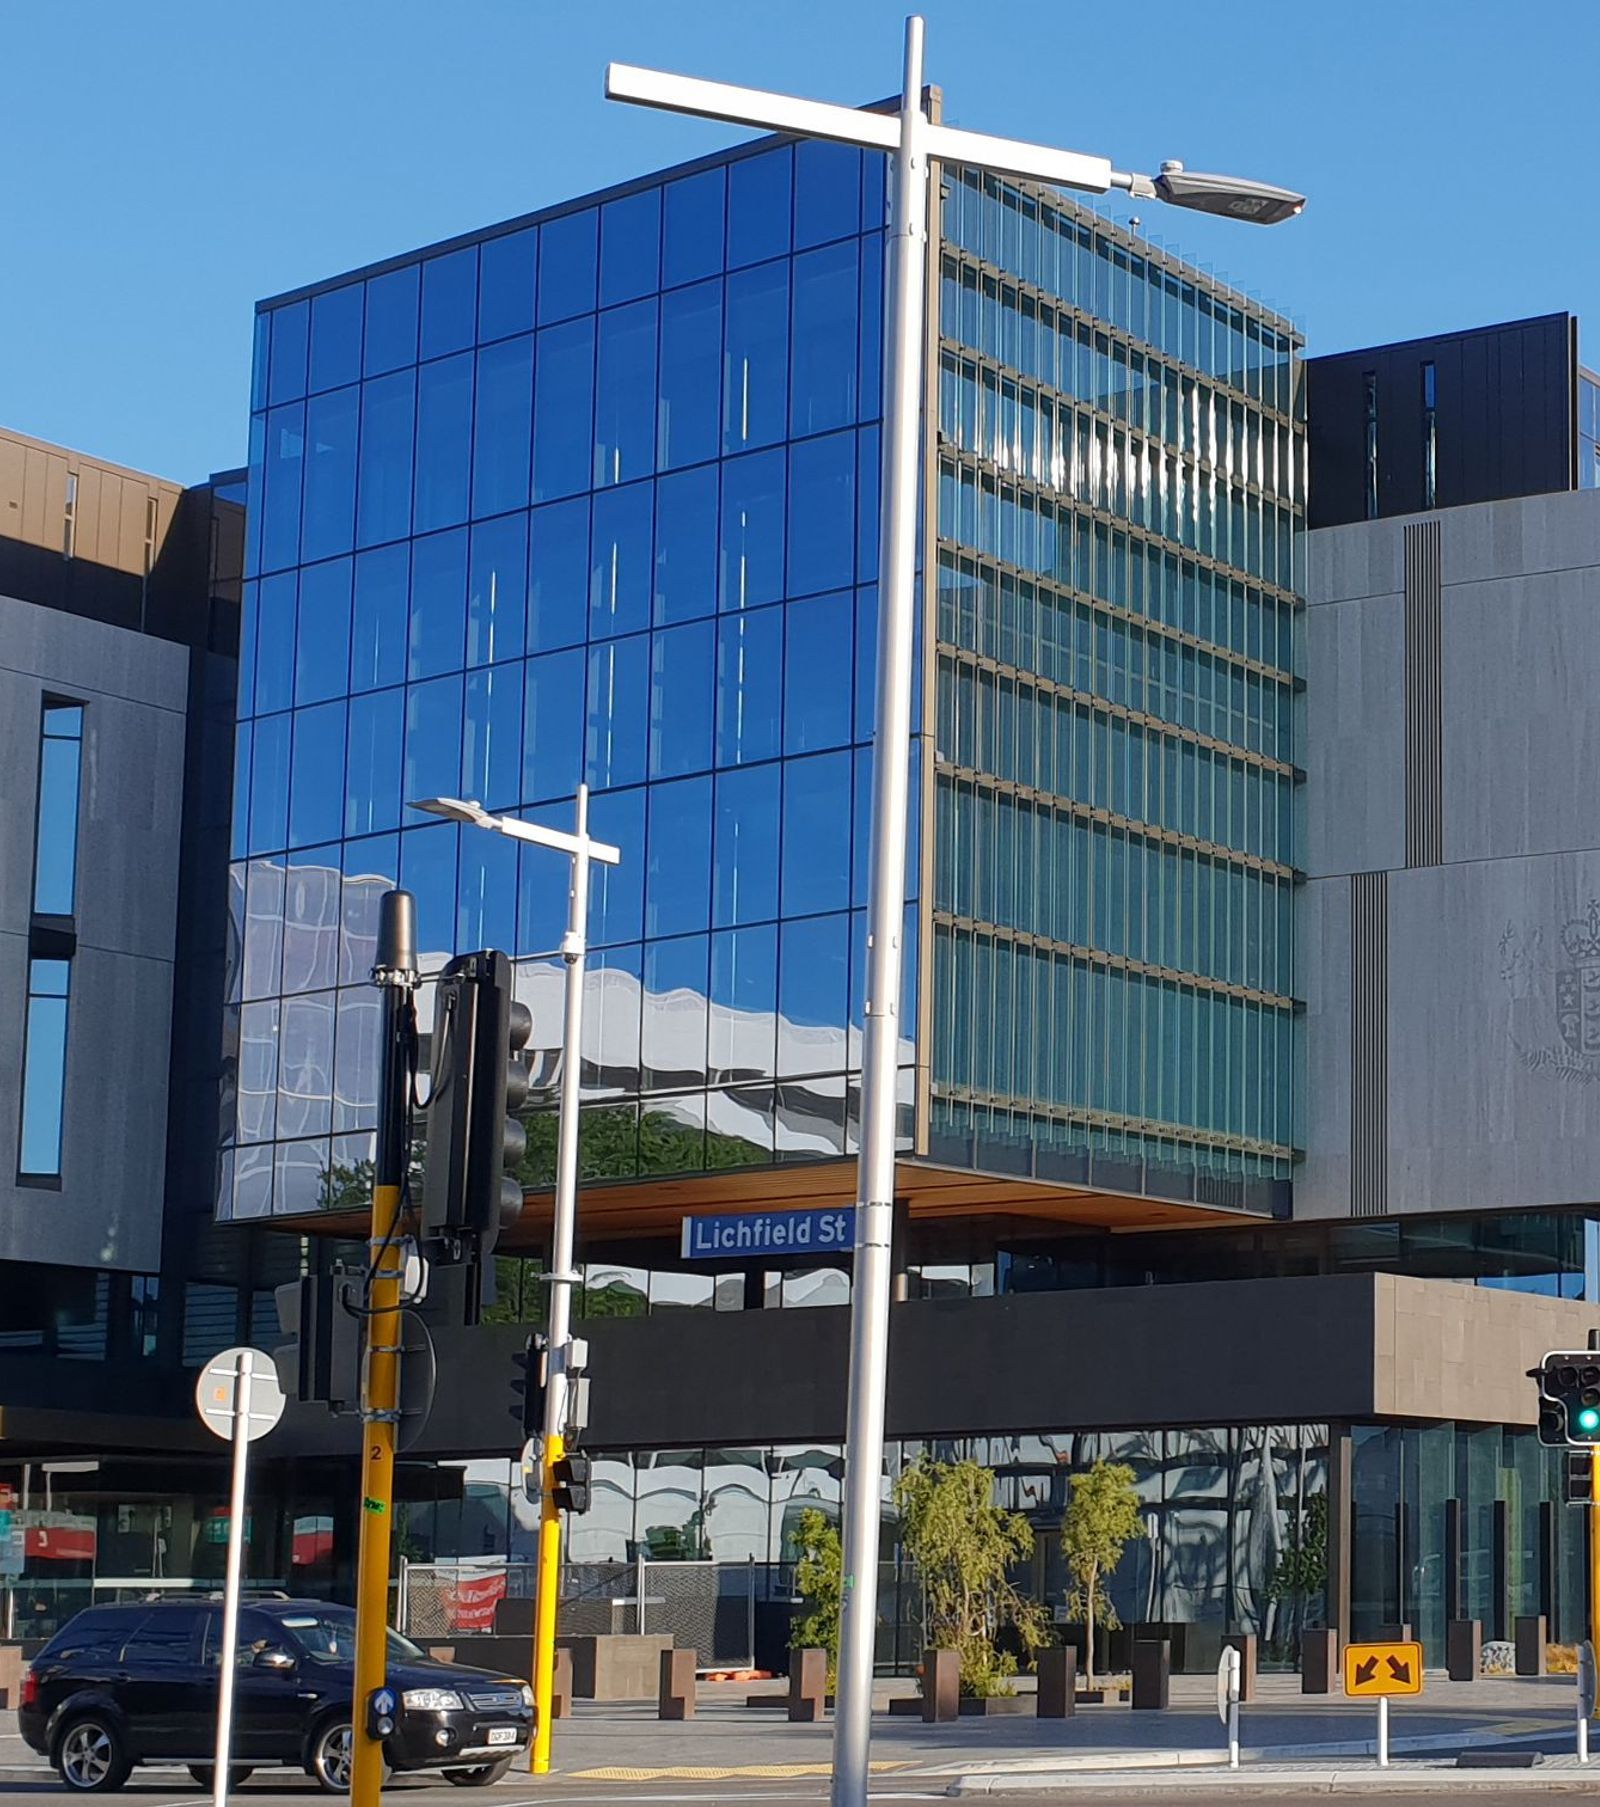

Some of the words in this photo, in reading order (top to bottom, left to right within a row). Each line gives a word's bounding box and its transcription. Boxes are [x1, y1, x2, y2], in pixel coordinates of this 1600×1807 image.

[696, 1216, 811, 1249] Lichfield
[818, 1214, 846, 1243] St
[370, 1445, 382, 1460] 2
